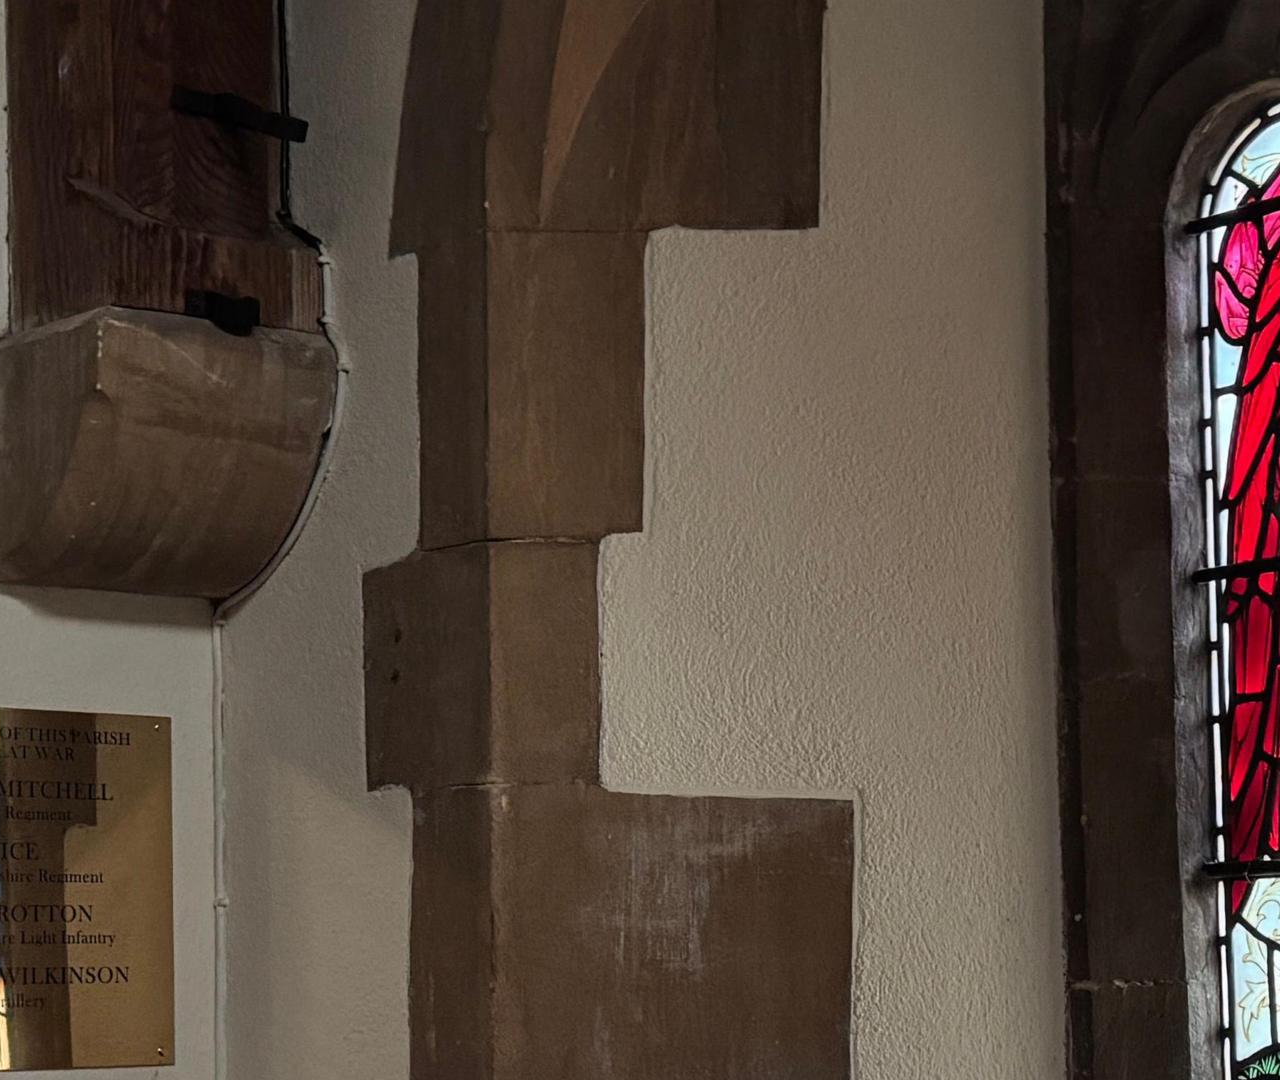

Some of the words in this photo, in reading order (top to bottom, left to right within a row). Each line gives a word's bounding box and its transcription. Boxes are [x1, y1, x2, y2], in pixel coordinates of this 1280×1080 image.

[1, 726, 24, 741] OF
[28, 726, 66, 743] THIS
[70, 729, 131, 747] PARISH
[37, 746, 75, 762] WAR
[5, 807, 72, 824] Regiment
[38, 869, 104, 887] Regiment
[0, 904, 94, 922] ROTTON
[20, 930, 57, 948] Light
[62, 930, 116, 947] Infantry
[0, 967, 130, 986] WILKINSON
